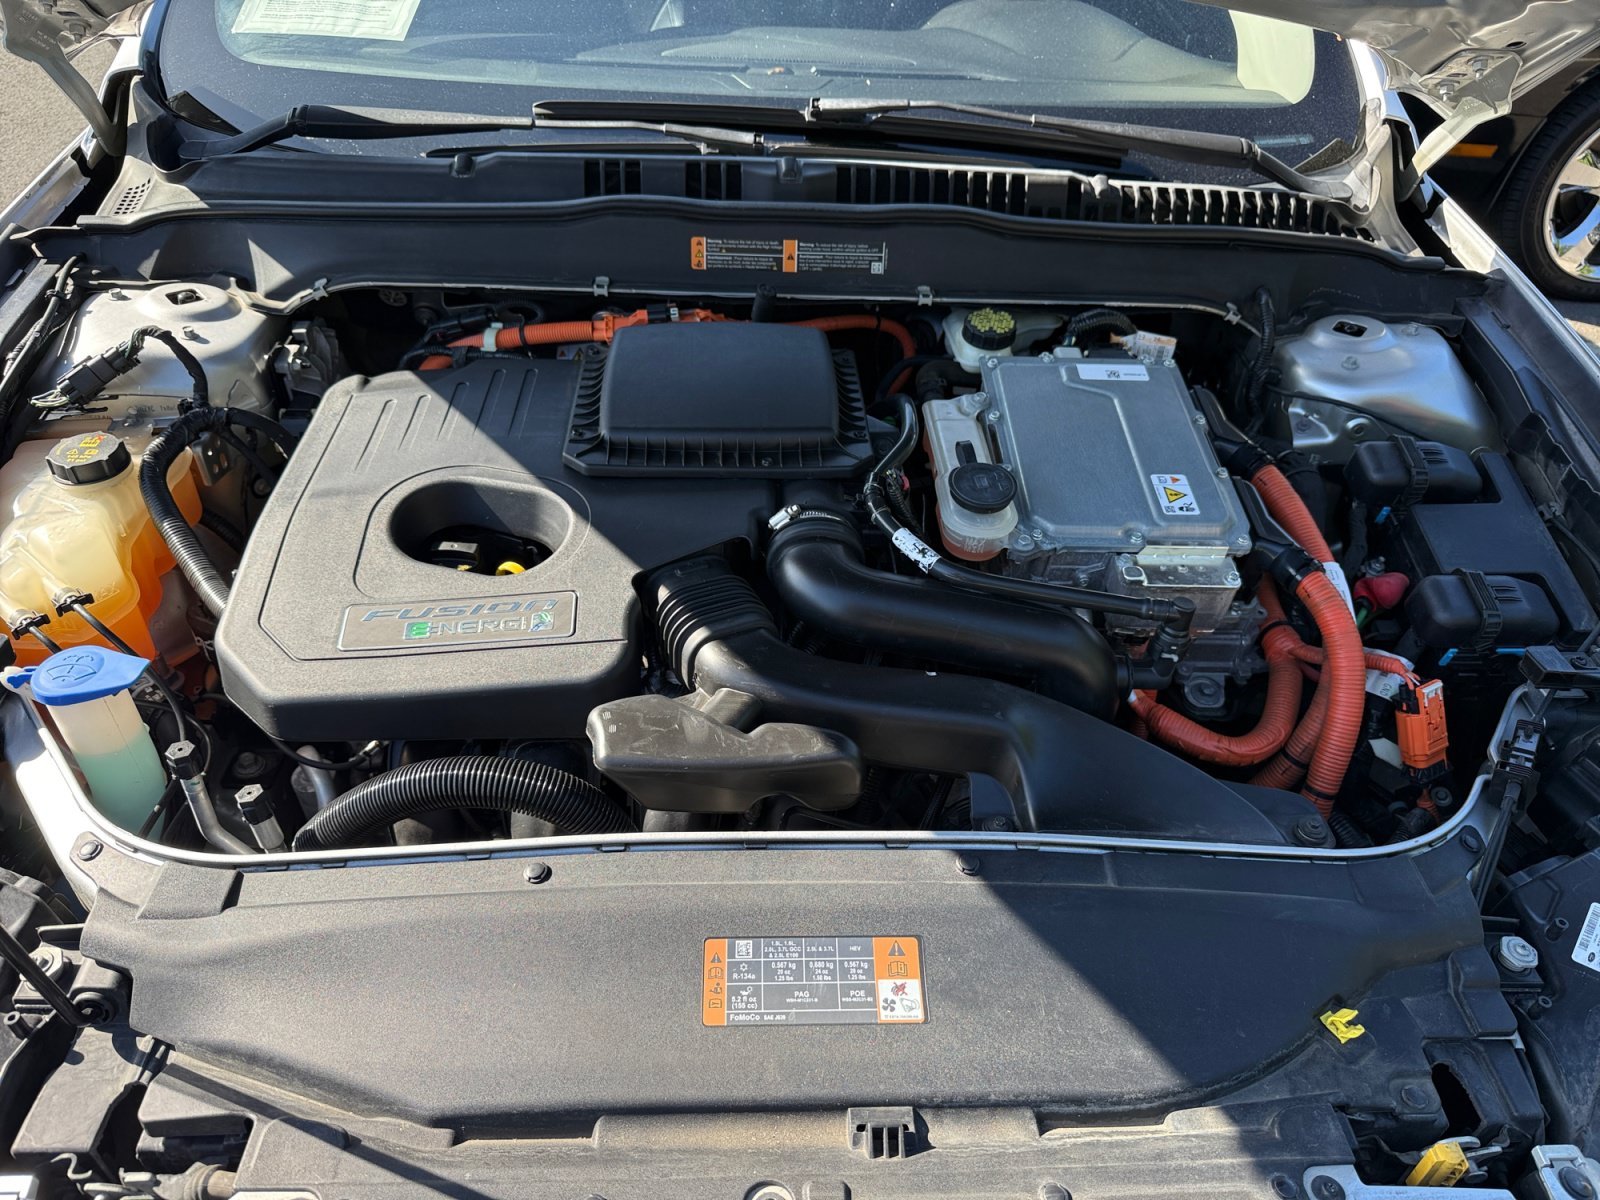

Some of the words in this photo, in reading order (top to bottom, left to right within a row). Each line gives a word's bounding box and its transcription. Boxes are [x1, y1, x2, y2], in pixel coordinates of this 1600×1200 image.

[361, 600, 559, 621] FUSION
[788, 961, 796, 970] kg
[826, 961, 834, 969] kg
[860, 961, 868, 969] kg
